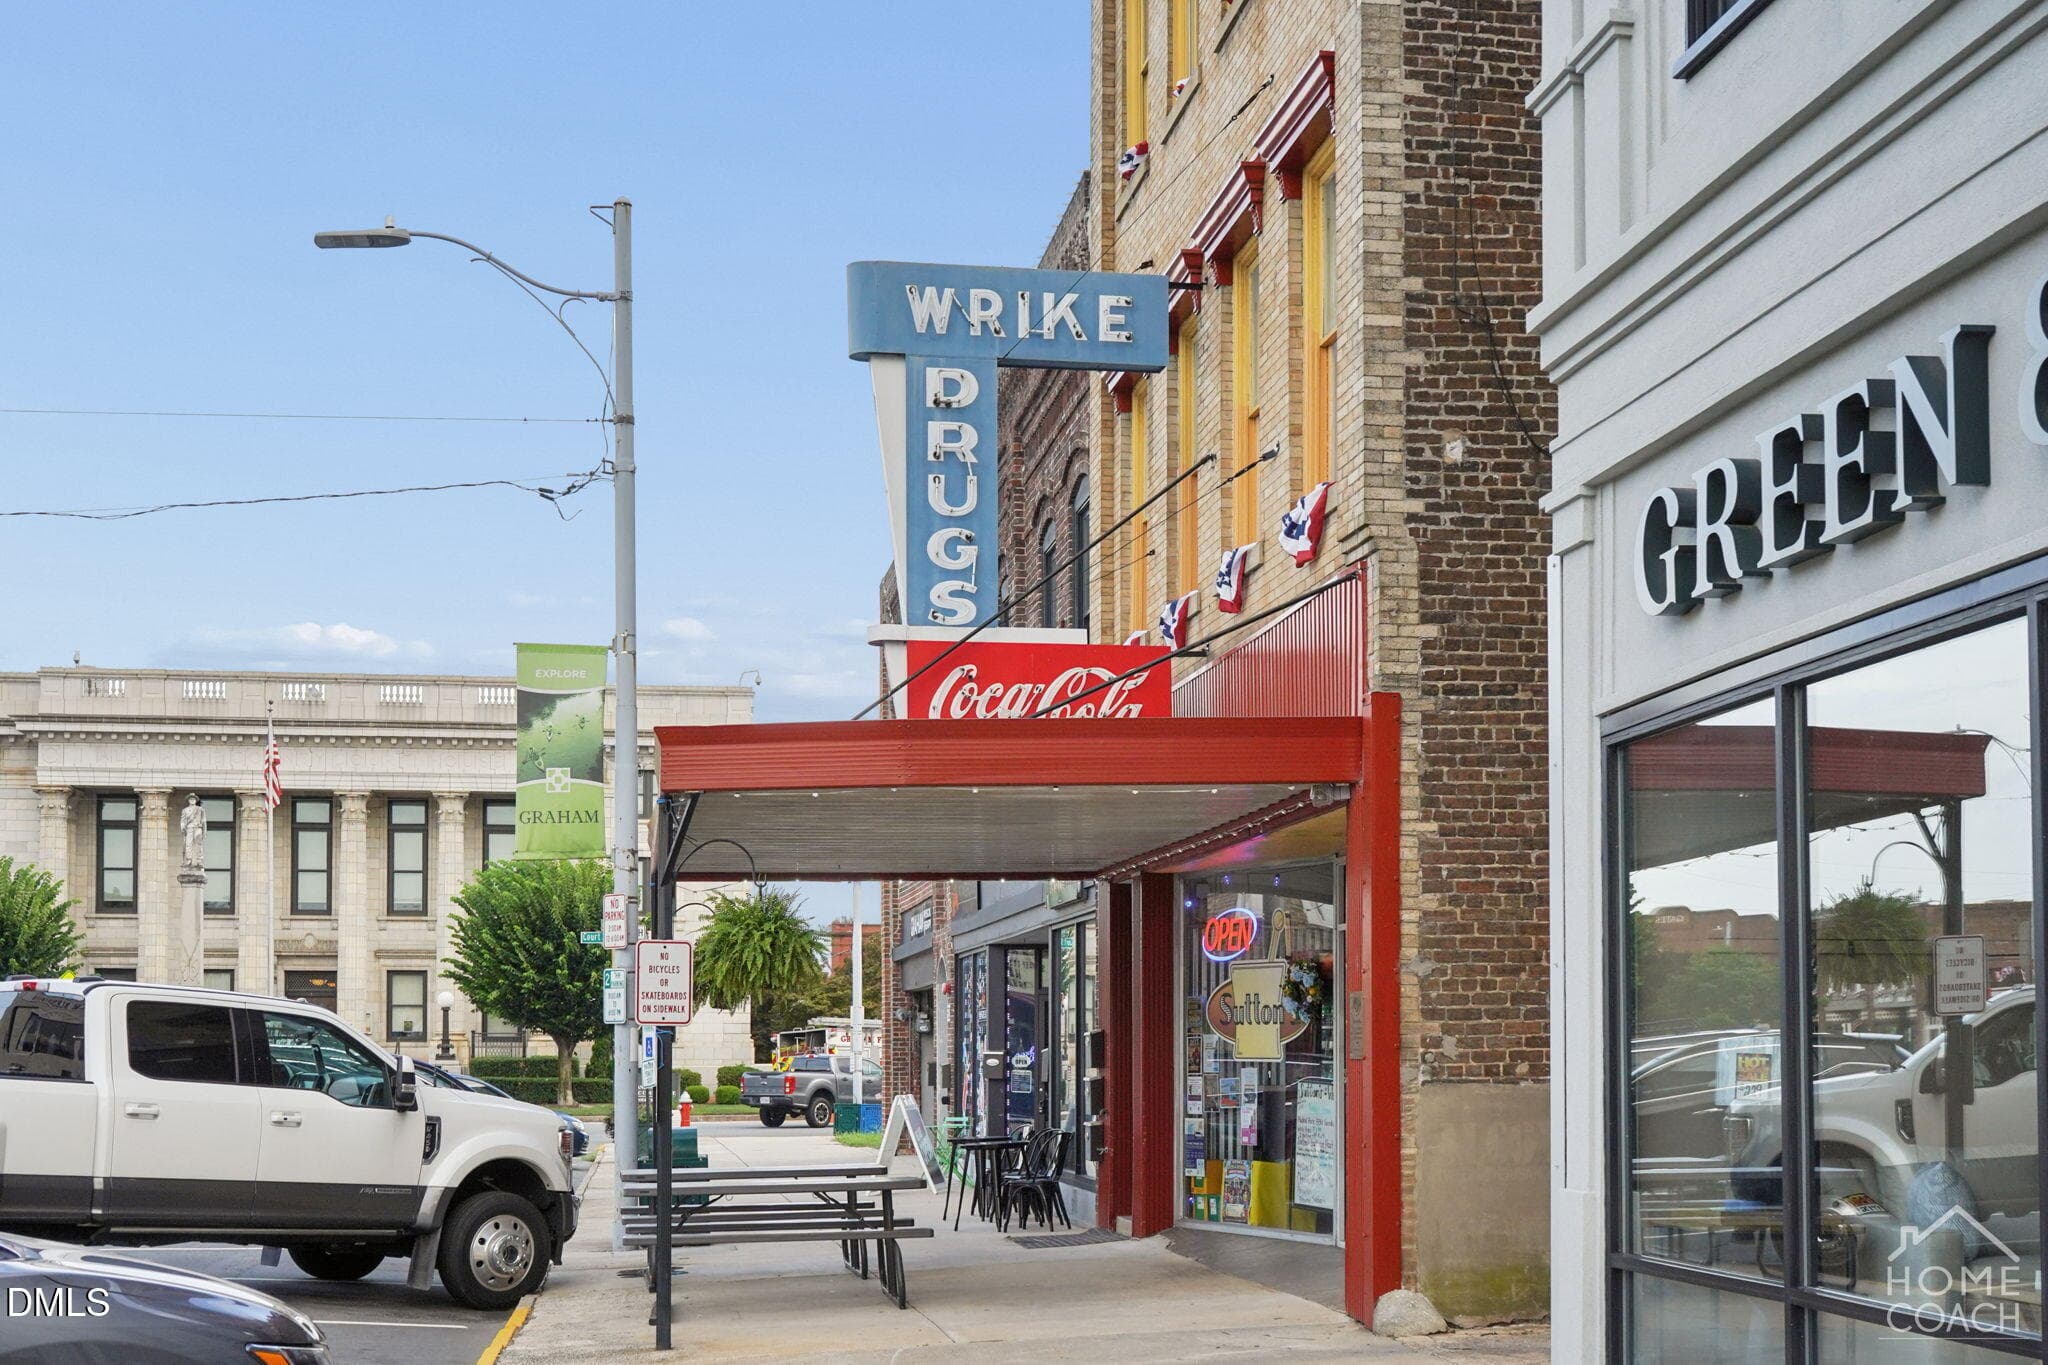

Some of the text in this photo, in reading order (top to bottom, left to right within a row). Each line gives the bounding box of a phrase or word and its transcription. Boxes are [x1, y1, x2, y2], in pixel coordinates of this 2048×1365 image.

[905, 284, 1134, 343] WRIKE
[1634, 324, 1993, 616] GREEN
[926, 367, 979, 625] DRUGS
[535, 669, 587, 679] EXPLORE
[519, 810, 599, 825] GRAHAM
[610, 899, 619, 909] NO
[605, 911, 625, 921] PARKING
[582, 933, 601, 941] Court
[1204, 917, 1253, 952] OPEN
[660, 952, 669, 961] NO
[648, 965, 681, 974] BICYCLES
[659, 978, 669, 987] OR
[641, 991, 687, 1000] SKATEBOARDS
[642, 1004, 686, 1013] ON SIDEWALK
[1737, 1056, 1769, 1069] HOT
